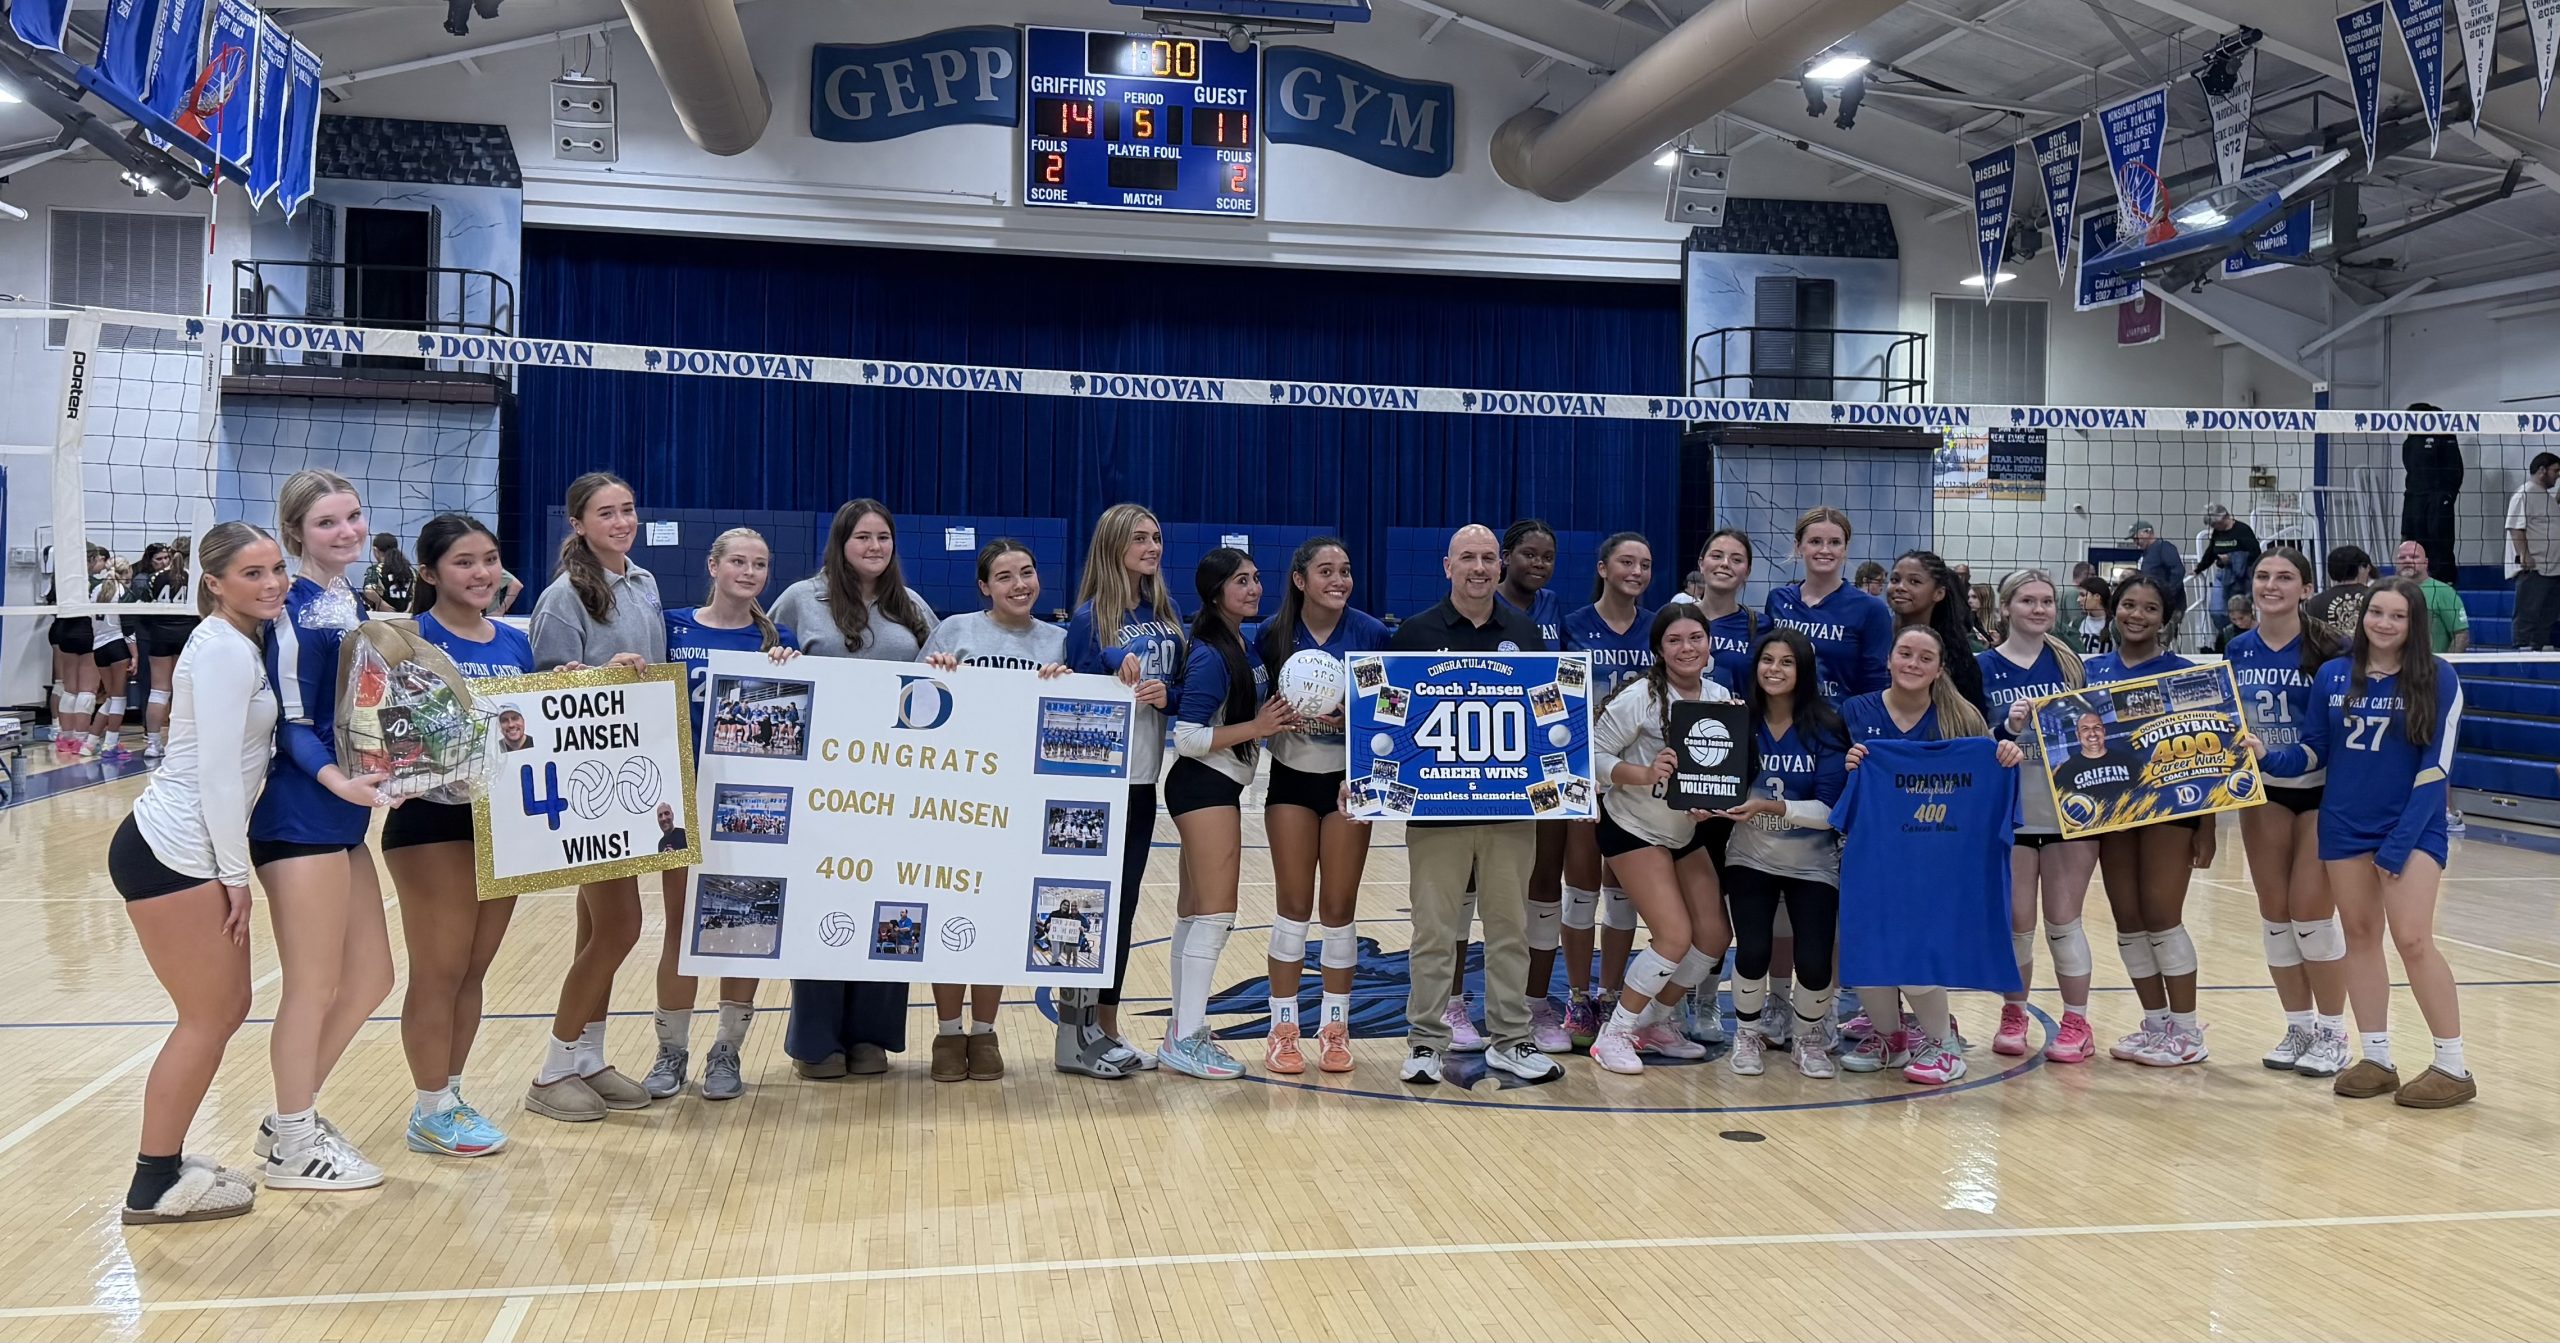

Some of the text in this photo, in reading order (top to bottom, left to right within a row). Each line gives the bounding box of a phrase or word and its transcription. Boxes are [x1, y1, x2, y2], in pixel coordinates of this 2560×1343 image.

[2352, 12, 2372, 29] GIRLS
[2471, 4, 2488, 17] STATE
[2469, 25, 2492, 39] 2007
[824, 42, 1014, 122] GEPP
[1031, 75, 1107, 97] GRIFFINS
[1124, 91, 1164, 105] PERIOD
[1194, 86, 1248, 105] GUEST
[1062, 103, 1094, 135] 14
[1279, 66, 1441, 154] GYM
[1135, 109, 1153, 138] 5
[1217, 112, 1248, 144] 11
[1031, 139, 1068, 152] FOULS
[2048, 131, 2067, 149] BOYS
[2222, 138, 2241, 158] 1972
[1107, 144, 1182, 160] PLAYER FOUL
[1216, 150, 1252, 164] FOULS
[1046, 154, 1063, 182] 2
[1230, 164, 1248, 193] 2
[1031, 187, 1068, 201] SCORE
[1123, 193, 1163, 206] MATCH
[1216, 198, 1252, 210] SCORE
[439, 336, 595, 367] DONOVAN
[665, 349, 815, 380] DONOVAN
[882, 362, 1024, 393] DONOVAN
[1088, 374, 1226, 402] DONOVAN
[1287, 383, 1420, 410] DONOVAN
[1480, 391, 1607, 416] DONOVAN
[1665, 398, 1791, 423] DONOVAN
[1848, 405, 1971, 428] DONOVAN
[2027, 407, 2148, 429] DONOVAN
[2201, 410, 2318, 430] DONOVAN
[2369, 412, 2481, 432] DONOVAN
[1147, 639, 1176, 676] 20
[1427, 658, 1514, 677] CONGRATULATIONS
[1415, 682, 1524, 696] Coach Jansen
[541, 690, 625, 721] COACH
[2255, 690, 2292, 724] 21
[1413, 701, 1526, 762] 400
[2139, 712, 2218, 734] DONOVAN CATHOLIC
[2139, 719, 2230, 749] VOLLEYBALL
[2343, 714, 2391, 752] 27
[552, 722, 639, 753] JANSEN
[2151, 732, 2222, 764] 400
[821, 738, 999, 775] CONGRATS
[2151, 752, 2227, 777] Career Wins!
[1420, 767, 1529, 779] CAREER WINS
[1895, 773, 1973, 789] DONOVAN
[2074, 765, 2130, 785] GRIFFIN
[2081, 775, 2125, 789] VOLLEYBALL
[2163, 767, 2220, 782] COACH JANSEN
[1417, 791, 1469, 801] countless
[1469, 782, 1477, 790] &
[1680, 781, 1737, 797] VOLLEYBALL
[1765, 777, 1785, 801] 3
[807, 788, 1009, 829] COACH JANSEN
[1423, 806, 1473, 815] DONOVAN
[1913, 803, 1947, 823] 400
[562, 831, 630, 865] WINS!
[815, 856, 983, 895] 400 WINS!
